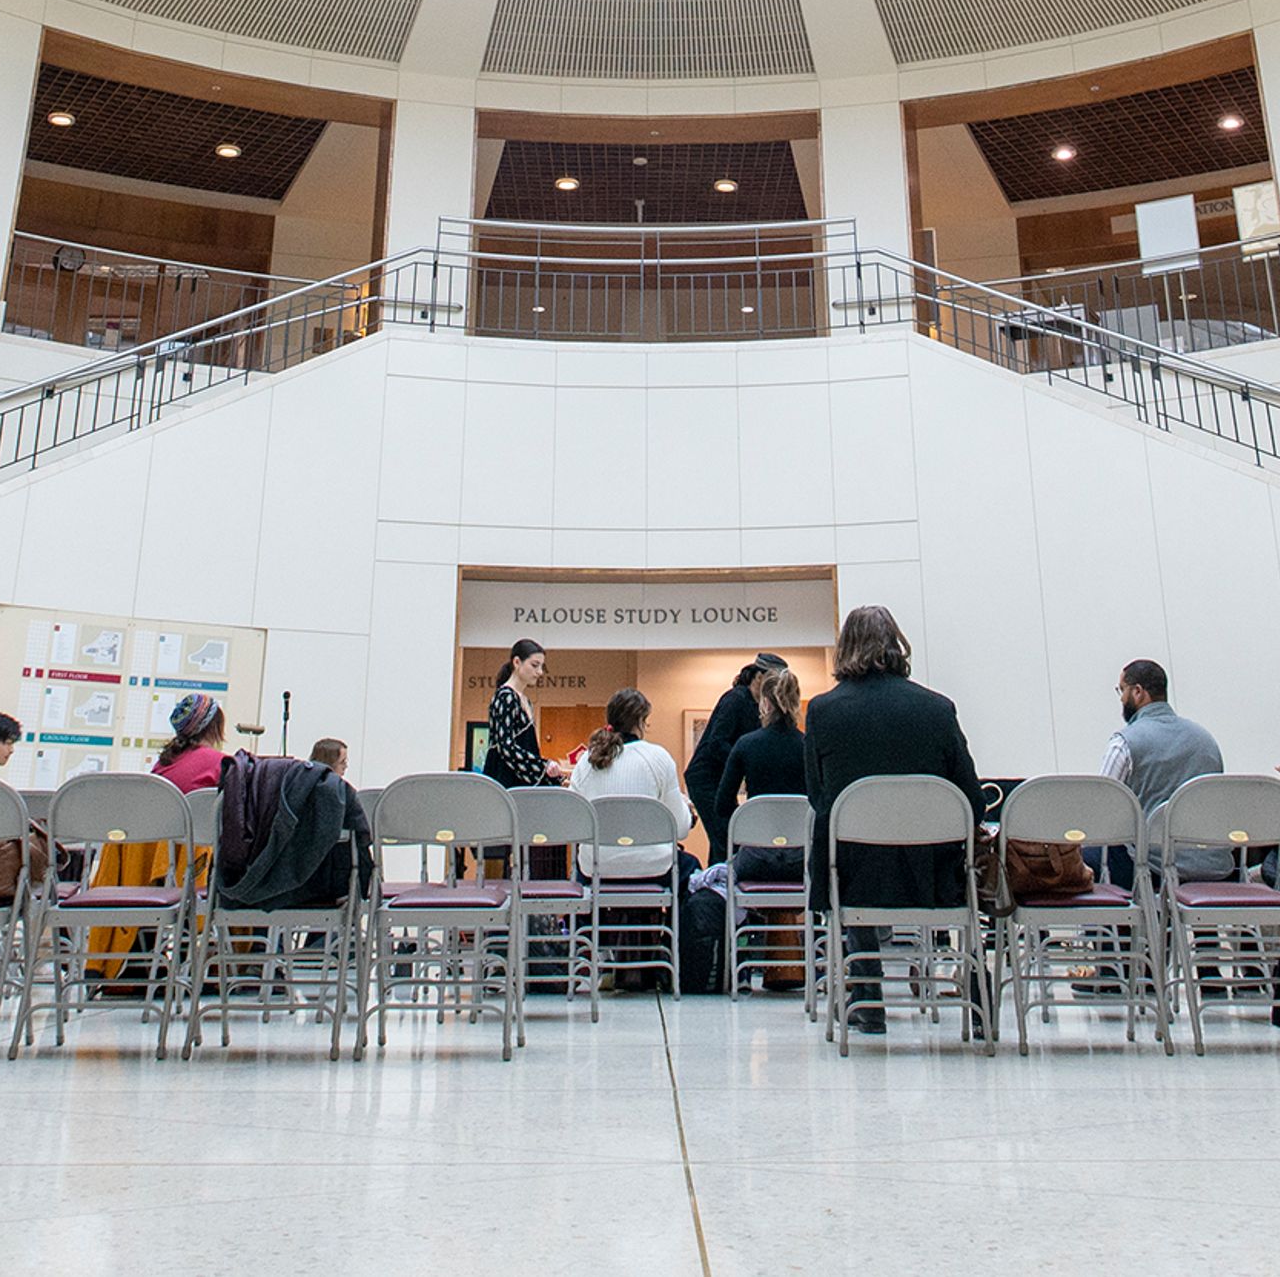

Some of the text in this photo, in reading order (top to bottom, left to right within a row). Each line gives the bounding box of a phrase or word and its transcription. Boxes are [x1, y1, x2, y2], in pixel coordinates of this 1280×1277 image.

[513, 606, 779, 625] PALOUSE STUDY LOUNGE
